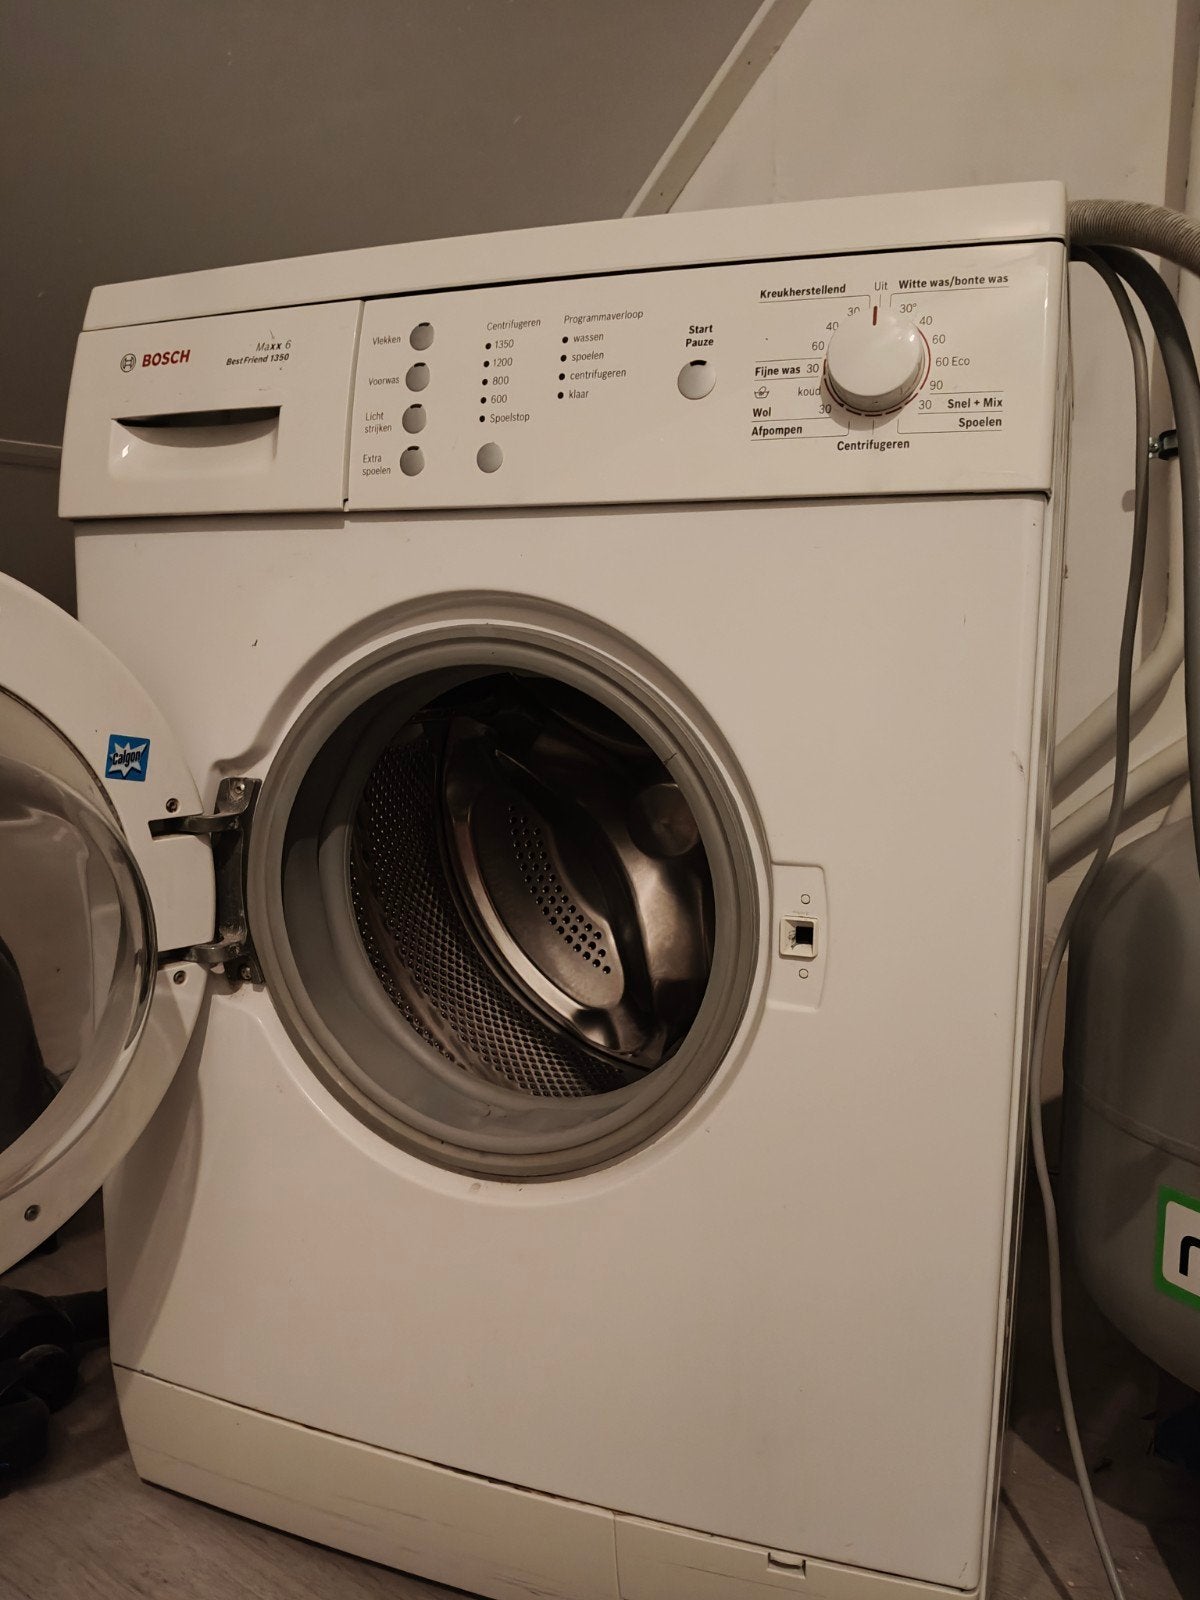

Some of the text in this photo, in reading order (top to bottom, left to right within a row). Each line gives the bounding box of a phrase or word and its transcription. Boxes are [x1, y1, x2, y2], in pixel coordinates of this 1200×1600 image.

[874, 281, 888, 291] Uit
[899, 275, 1008, 289] Witte was/bonte was
[760, 285, 846, 298] Kreukherstellend
[563, 310, 644, 325] Programmaverloop
[919, 316, 932, 326] 40
[486, 318, 541, 331] Centrifugeren
[689, 325, 713, 334] Start
[826, 321, 839, 331] 40
[372, 335, 401, 345] Vlekken
[573, 332, 604, 343] wassen
[686, 338, 714, 347] Pauze
[932, 334, 945, 344] 60
[256, 340, 291, 352] Maxx 6
[494, 339, 514, 348] 1350
[812, 341, 824, 351] 60
[142, 350, 191, 367] BOSCH
[270, 353, 289, 362] 1350
[571, 351, 604, 362] spoelen
[935, 356, 970, 366] 60 Eco
[493, 357, 513, 367] 1200
[755, 366, 800, 377] Fijne was
[806, 364, 819, 373] 30
[570, 369, 626, 381] centrifugeren
[368, 376, 400, 386] Voorwas
[492, 376, 509, 385] 800
[929, 380, 943, 390] 90
[568, 389, 589, 399] klaar
[798, 386, 820, 397] koud
[491, 394, 508, 404] 600
[947, 399, 971, 409] Snel
[983, 398, 1002, 408] Mix
[819, 404, 831, 414] 30
[918, 400, 932, 410] 30
[365, 412, 384, 421] Licht
[752, 407, 771, 417] Wol
[489, 413, 530, 424] Spoelstop
[959, 417, 1002, 428] Spoelen
[364, 423, 392, 434] strijken
[752, 425, 803, 437] Afpompen
[837, 439, 910, 451] Centrifugeren
[363, 454, 382, 463] Extra
[362, 466, 391, 476] spoelen
